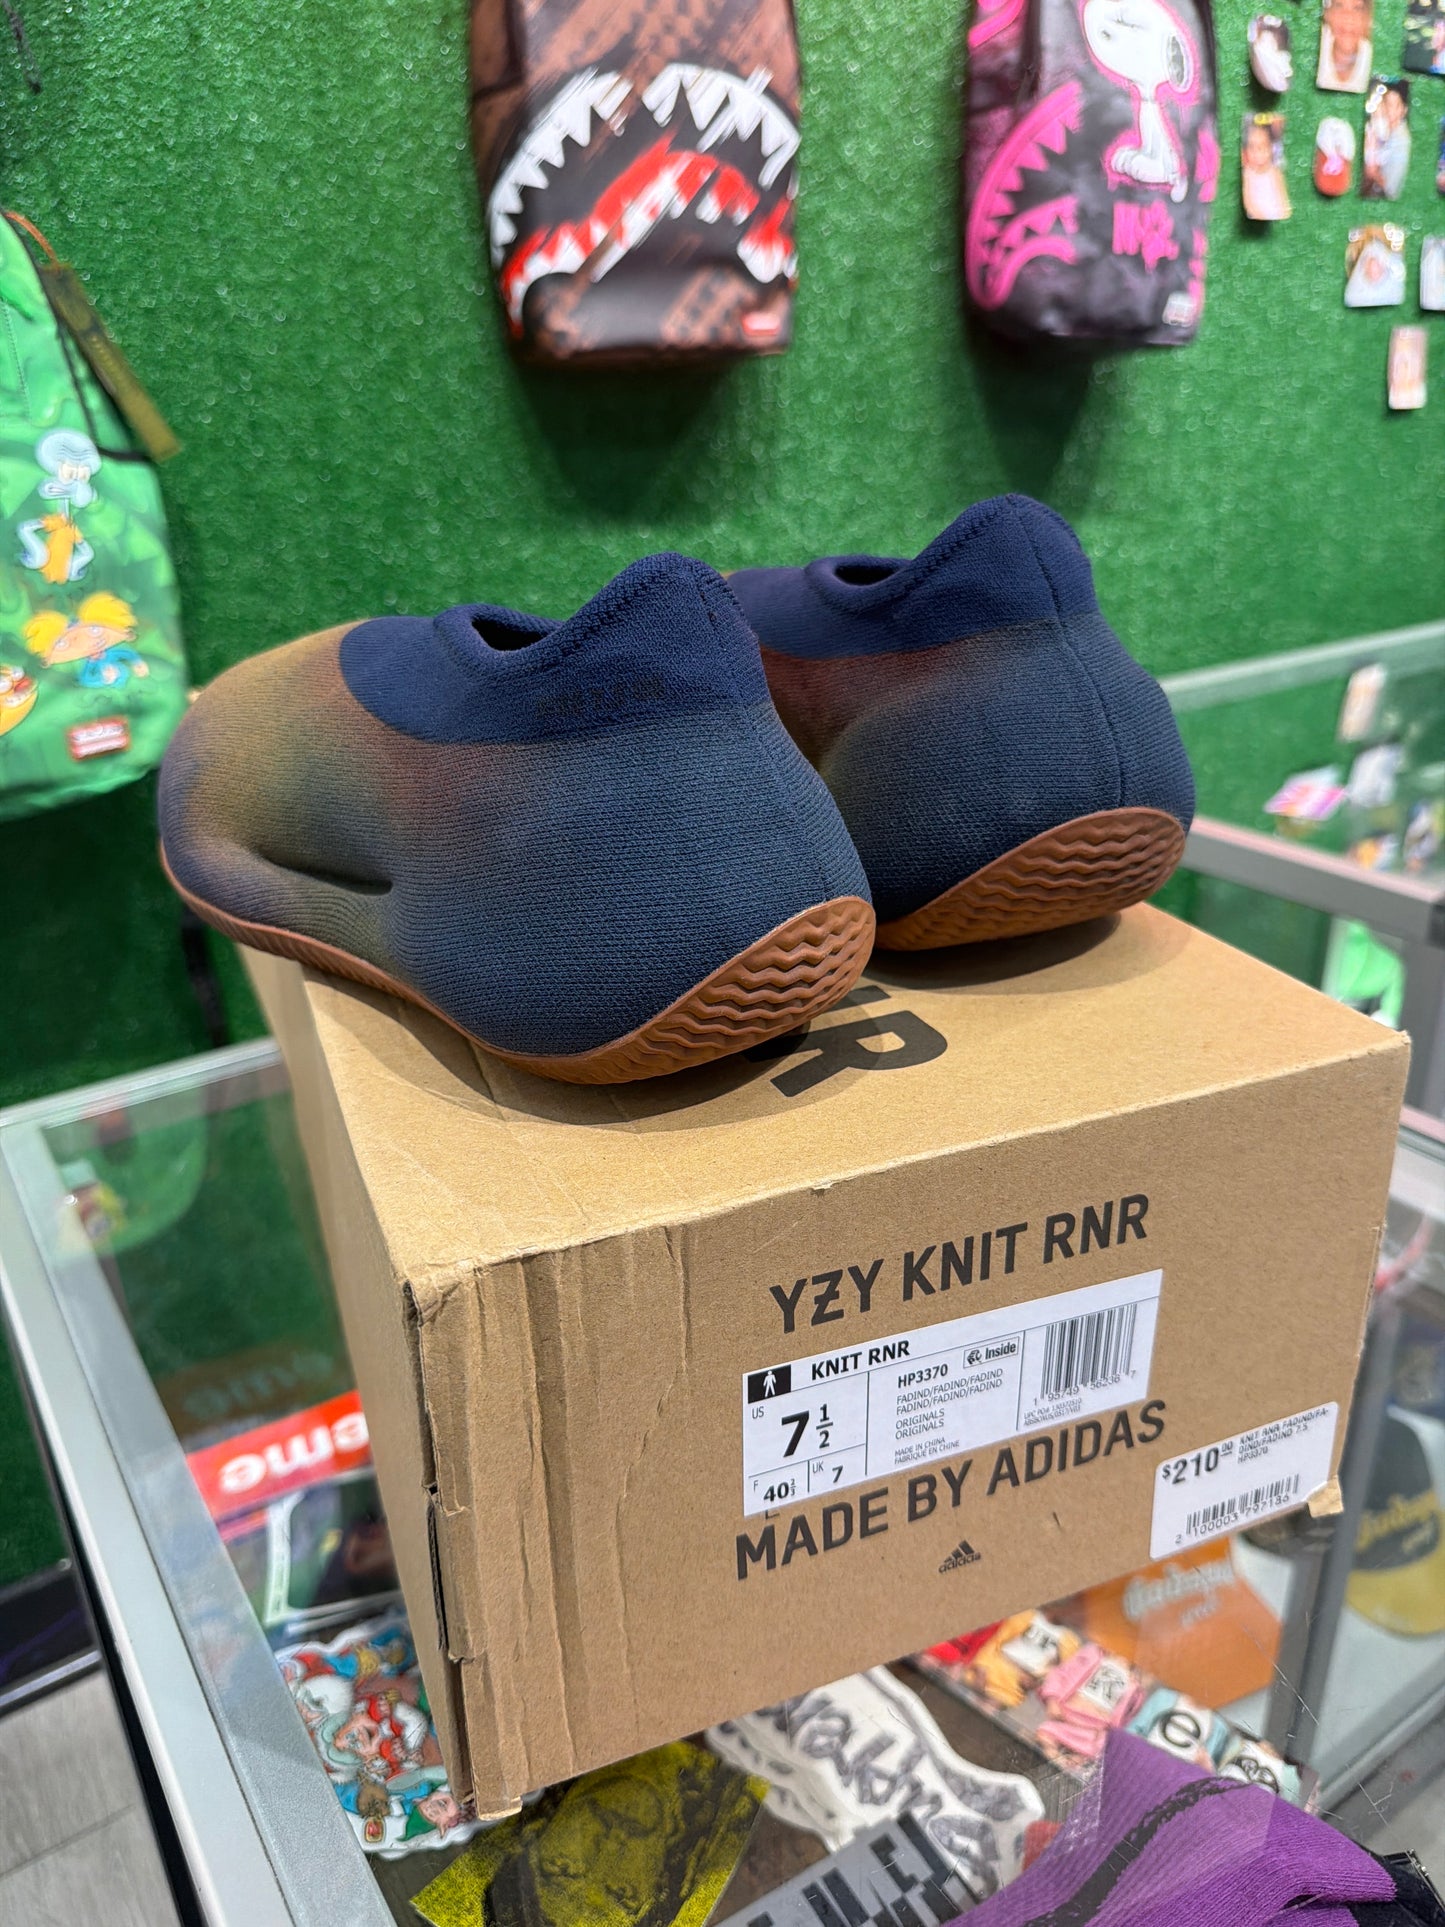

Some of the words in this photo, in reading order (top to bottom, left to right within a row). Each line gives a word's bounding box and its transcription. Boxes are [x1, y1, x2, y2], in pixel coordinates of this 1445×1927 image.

[902, 1222, 1028, 1301] KNIT
[1043, 1193, 1149, 1264] RNR
[812, 1352, 862, 1380] KNIT
[868, 1340, 910, 1366] RNR
[985, 1342, 1016, 1360] Inside
[896, 1368, 1003, 1405] FADIND/FADIND/FADIND
[897, 1364, 948, 1388] HP3370
[896, 1379, 1003, 1415] FADIND/FADIND/FADIND
[752, 1406, 764, 1419] US
[895, 1408, 945, 1430] ORIGINALS
[781, 1410, 809, 1458] 7
[895, 1418, 944, 1440] ORIGINALS
[1239, 1431, 1259, 1445] KNIT
[895, 1445, 913, 1456] MADE
[915, 1443, 922, 1451] IN
[925, 1437, 945, 1448] CHINA
[928, 1447, 937, 1455] EN
[939, 1440, 960, 1452] CHINE
[813, 1461, 824, 1474] UK
[832, 1465, 843, 1483] 7
[736, 1486, 889, 1580] MADE
[907, 1459, 973, 1523] BY
[987, 1400, 1166, 1496] ADIDAS
[753, 1480, 759, 1492] F
[1175, 1534, 1182, 1545] 2
[1193, 1513, 1239, 1537] 100003
[938, 1551, 982, 1573] adidas
